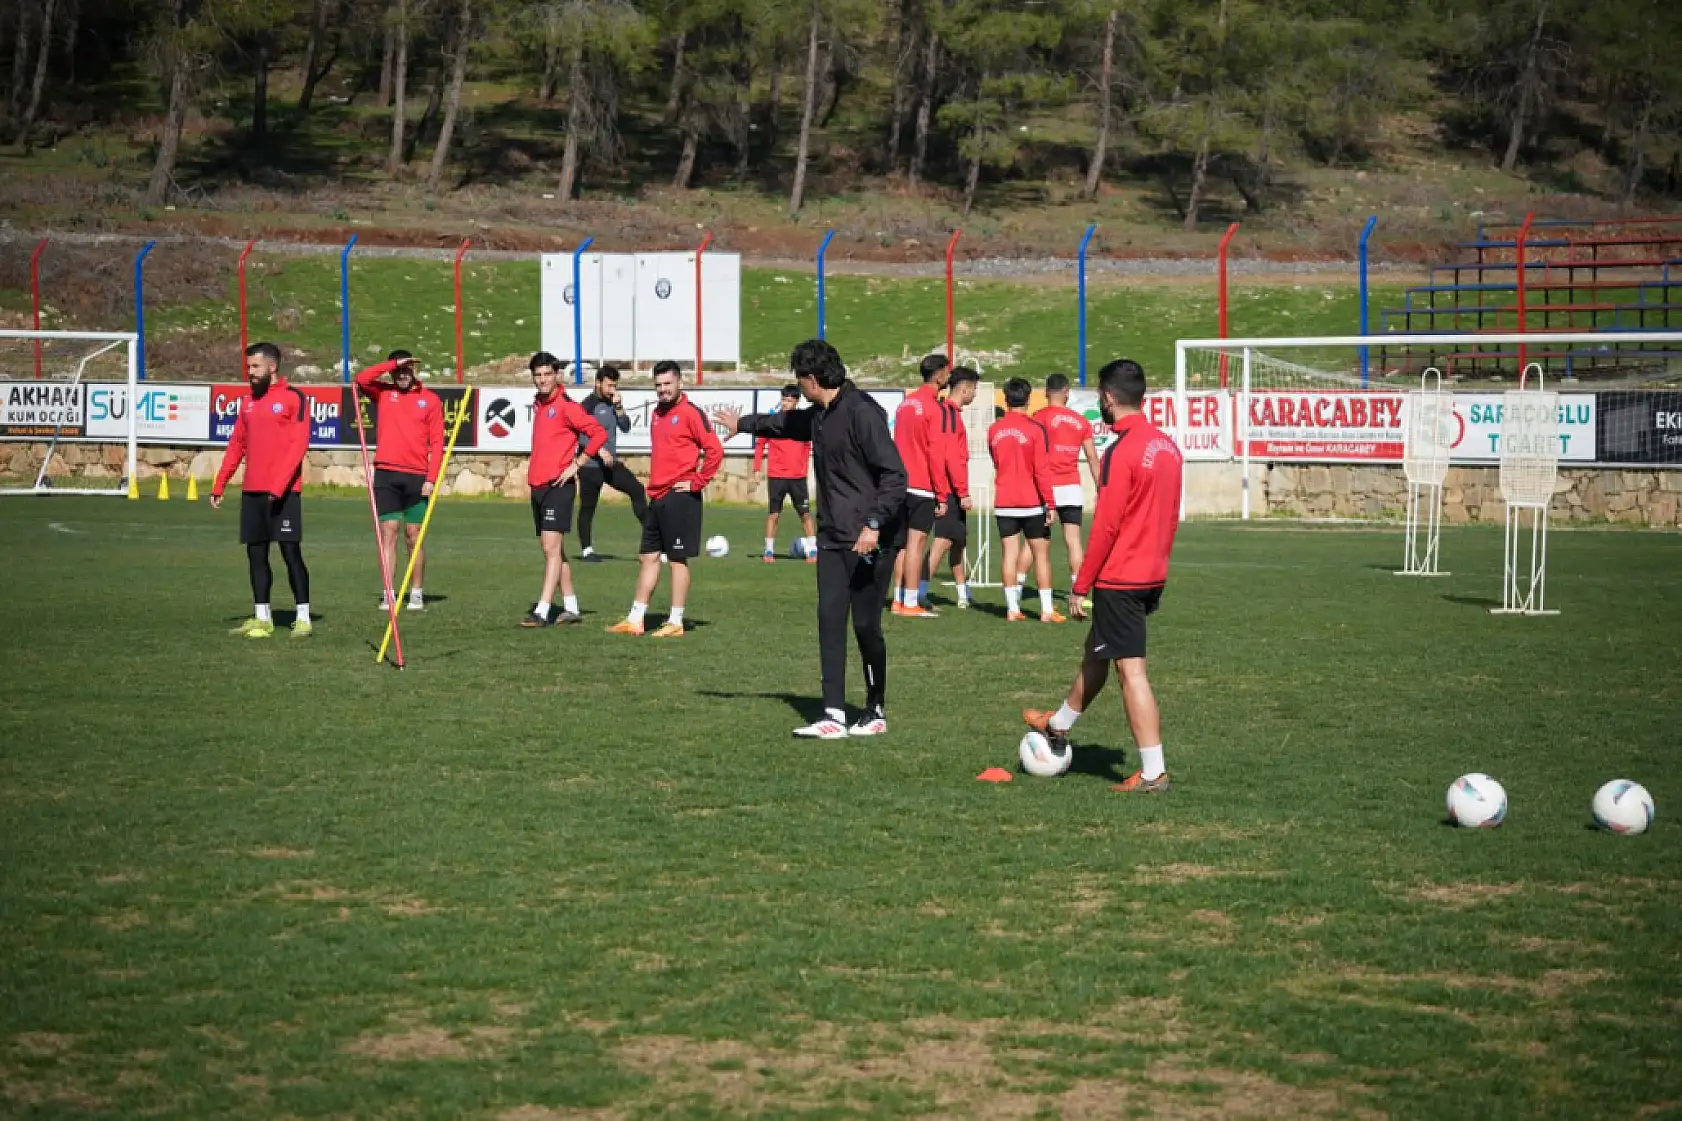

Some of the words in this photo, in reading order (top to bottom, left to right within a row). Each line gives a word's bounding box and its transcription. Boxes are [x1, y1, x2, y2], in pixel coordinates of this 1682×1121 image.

[9, 386, 79, 406] AKHAN
[8, 411, 35, 422] KUM
[1249, 397, 1404, 428] KARACABEY
